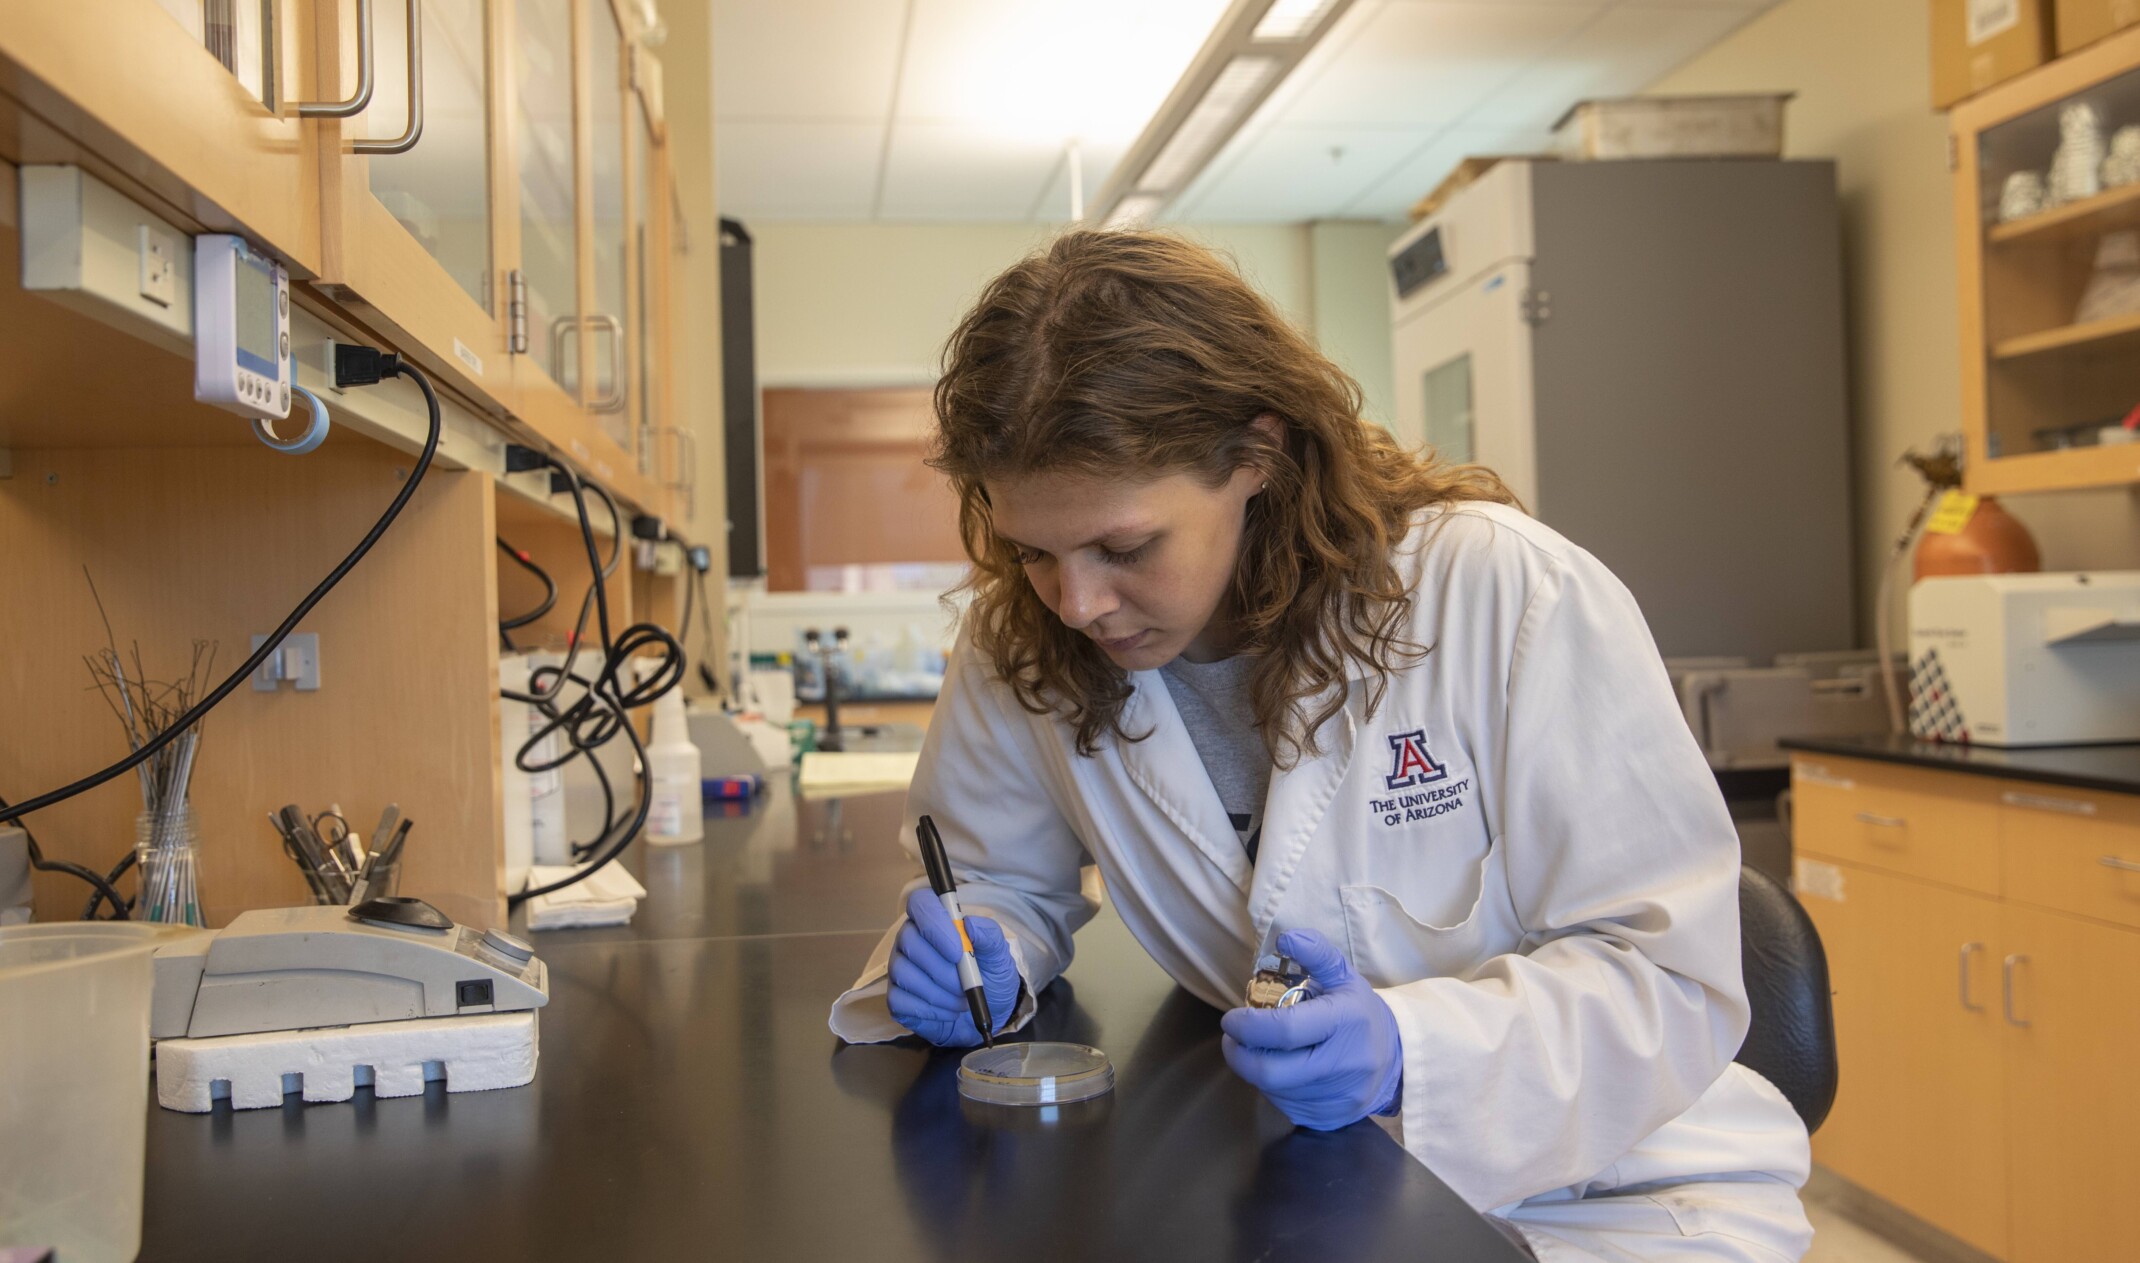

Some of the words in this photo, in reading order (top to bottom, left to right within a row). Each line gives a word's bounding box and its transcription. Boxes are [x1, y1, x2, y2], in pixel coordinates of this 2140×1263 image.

[1386, 728, 1448, 790] A
[1369, 799, 1397, 813] THE
[1398, 779, 1469, 808] UNIVERSITY
[1384, 814, 1401, 826] OF
[1405, 798, 1463, 822] ARIZONA
